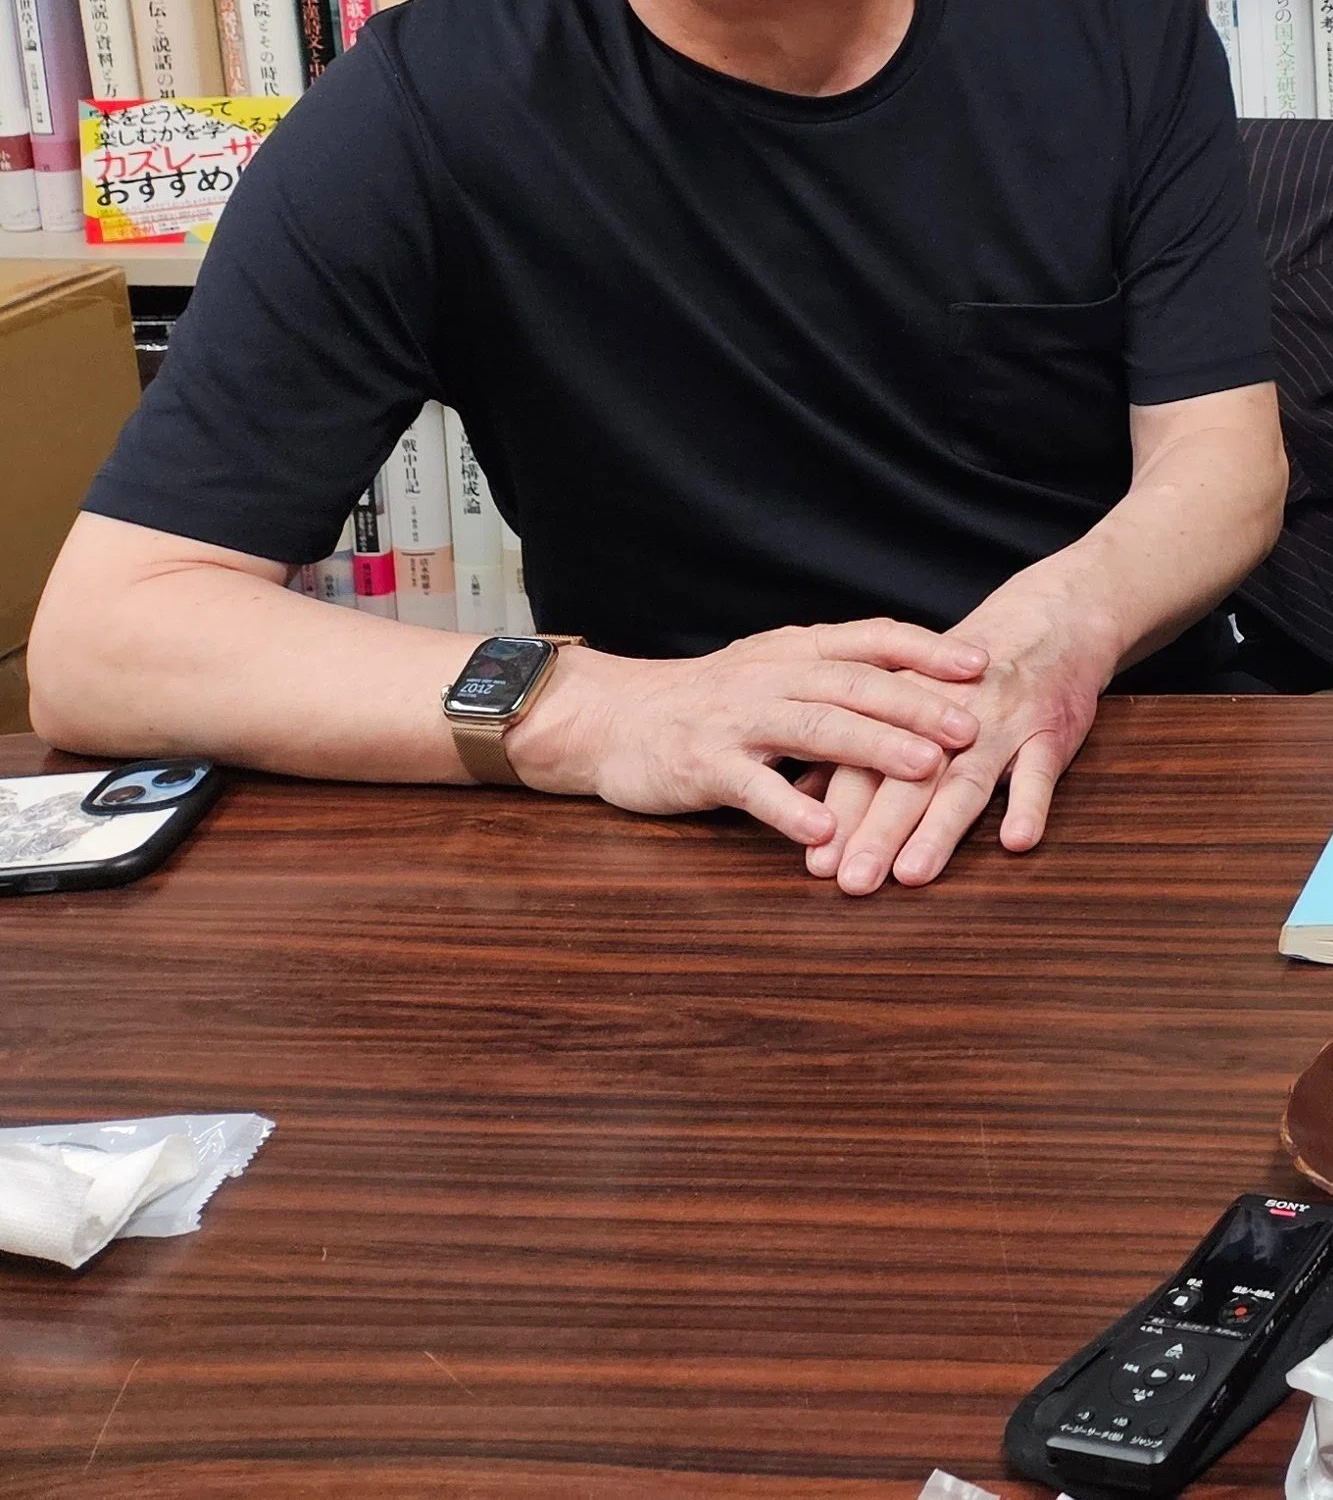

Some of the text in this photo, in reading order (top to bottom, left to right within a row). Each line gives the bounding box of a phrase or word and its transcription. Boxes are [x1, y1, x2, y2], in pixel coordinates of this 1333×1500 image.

[96, 136, 264, 181] カズレーザ
[1264, 1198, 1311, 1214] SONY
